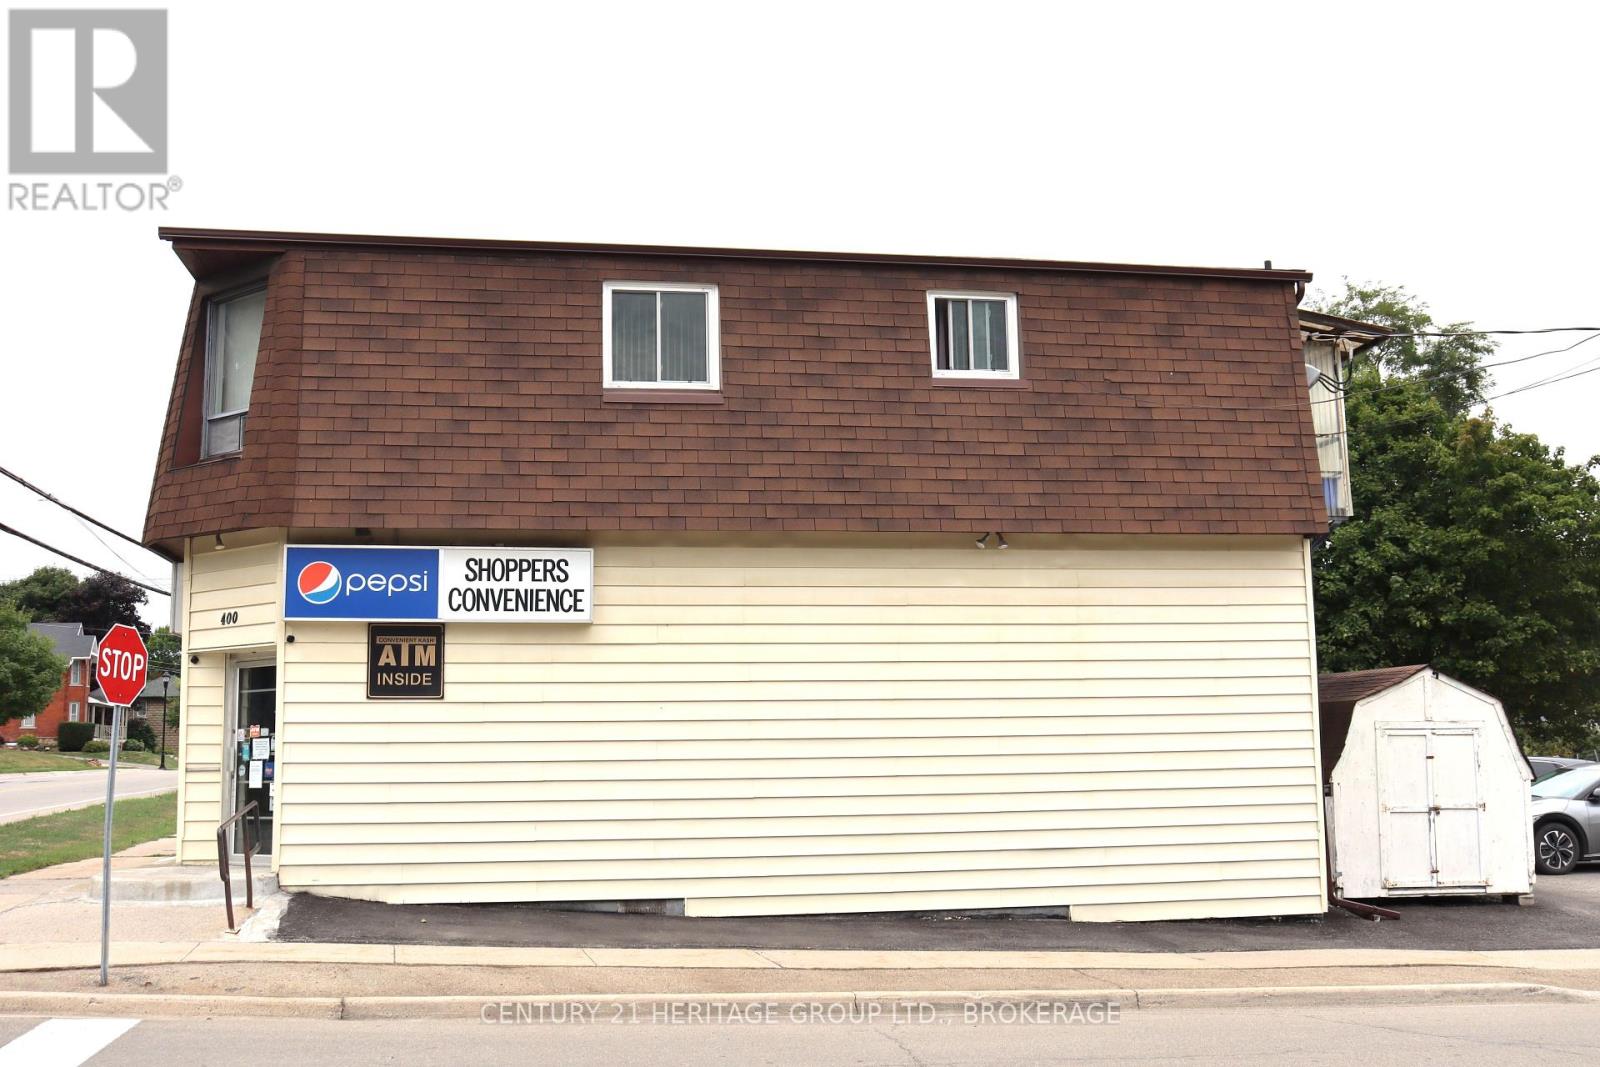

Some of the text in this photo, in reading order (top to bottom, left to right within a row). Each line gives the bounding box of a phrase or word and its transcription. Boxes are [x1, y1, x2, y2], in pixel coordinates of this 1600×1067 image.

[464, 557, 569, 583] SHOPPERS
[346, 570, 428, 596] pepsi
[448, 587, 585, 612] CONVENIENCE
[220, 611, 239, 626] 400
[100, 648, 145, 682] STOP
[377, 643, 436, 667] ATM
[377, 672, 432, 686] INSIDE
